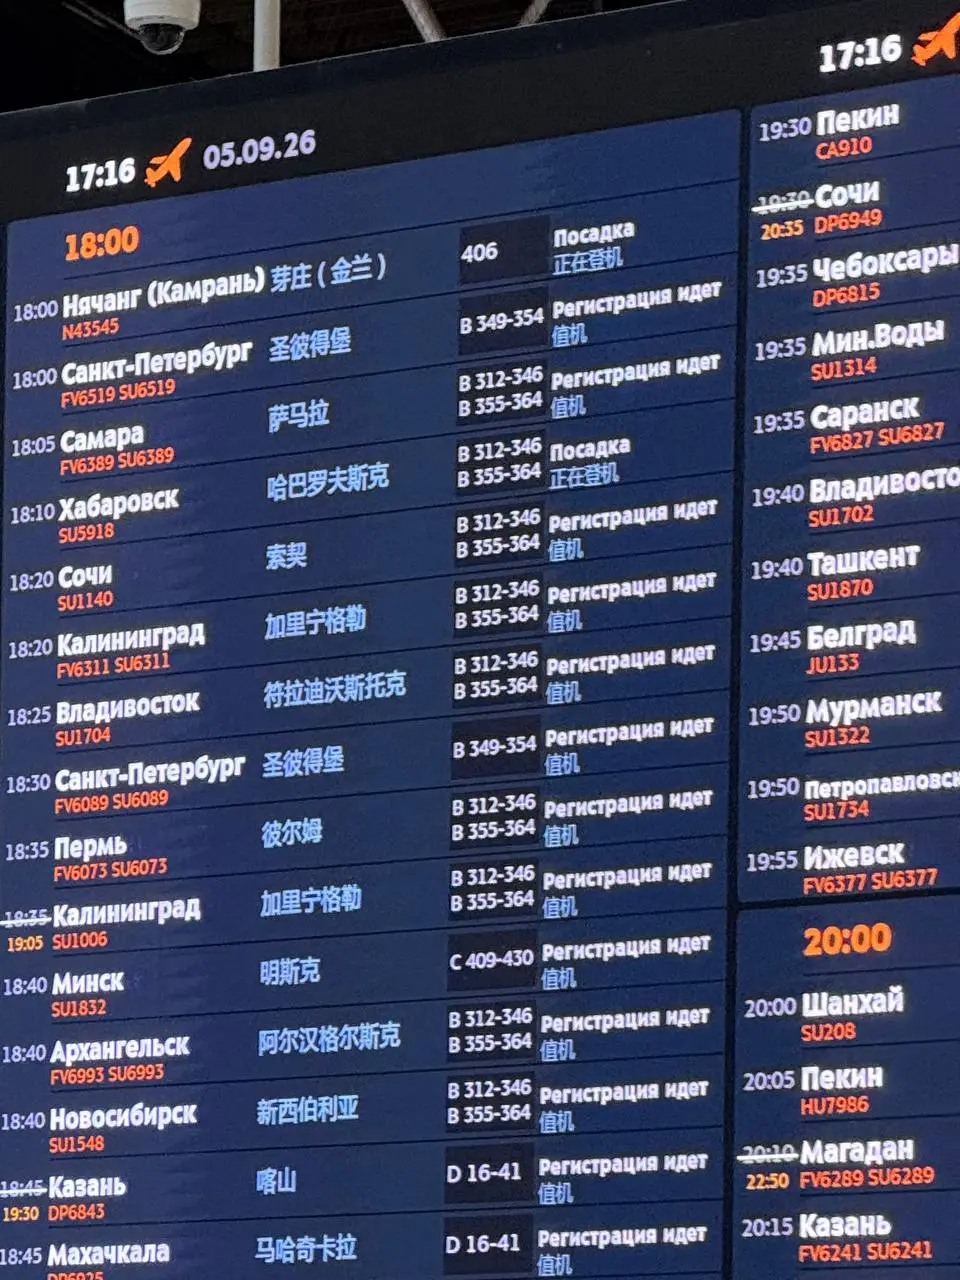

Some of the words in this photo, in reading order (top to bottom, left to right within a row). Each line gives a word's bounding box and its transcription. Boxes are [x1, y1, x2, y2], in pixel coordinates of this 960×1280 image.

[819, 33, 903, 73] 17:16
[816, 103, 900, 136] Пекин
[66, 157, 136, 193] 17:16
[203, 129, 316, 170] 05.09.26
[816, 135, 873, 160] CA910
[812, 180, 880, 209] Сочи
[65, 225, 140, 261] 18:00
[553, 221, 635, 248] Посадка
[460, 241, 499, 263] 406
[552, 246, 624, 276] 正在登机
[812, 243, 960, 282] Чебоксары
[62, 288, 143, 319] Нячанг
[147, 265, 266, 308] (Камрань)
[812, 281, 881, 308] DP6815
[811, 319, 945, 357] Мин.Воды
[61, 341, 254, 386] Санкт-Петербург
[809, 396, 921, 432] Саранск
[59, 425, 145, 454] Самара
[57, 488, 180, 522] Хабаровск
[59, 522, 115, 544] SU5918
[806, 544, 921, 577] Ташкент
[9, 570, 55, 592] 18:20
[57, 564, 113, 589] Сочи
[807, 578, 874, 601] SU1870
[58, 590, 113, 612] SU1140
[57, 622, 206, 657] Калининград
[750, 630, 802, 653] 19:45
[807, 619, 917, 651] Белград
[807, 652, 860, 674] JU133
[56, 691, 201, 725] Владивосток
[805, 691, 943, 728] Мурманск
[55, 726, 111, 747] SU1704
[54, 754, 247, 792] Санкт-Петербург
[54, 835, 128, 863] Пермь
[803, 842, 906, 871] Ижевск
[52, 897, 202, 928] Калининград
[803, 922, 893, 957] 20:00
[51, 971, 125, 996] Минск
[51, 999, 106, 1018] SU1832
[744, 997, 797, 1018] 20:00
[801, 984, 905, 1018] Шанхай
[49, 1035, 191, 1068] Архангельск
[800, 1065, 884, 1092] Пекин
[49, 1101, 198, 1131] Новосибирск
[800, 1095, 870, 1115] HU7986
[799, 1139, 915, 1167] Магадан
[48, 1175, 128, 1199] Казань
[798, 1213, 893, 1239] Казань
[47, 1242, 171, 1267] Махачкала
[445, 1235, 461, 1254] D
[466, 1233, 520, 1254] 16-41
